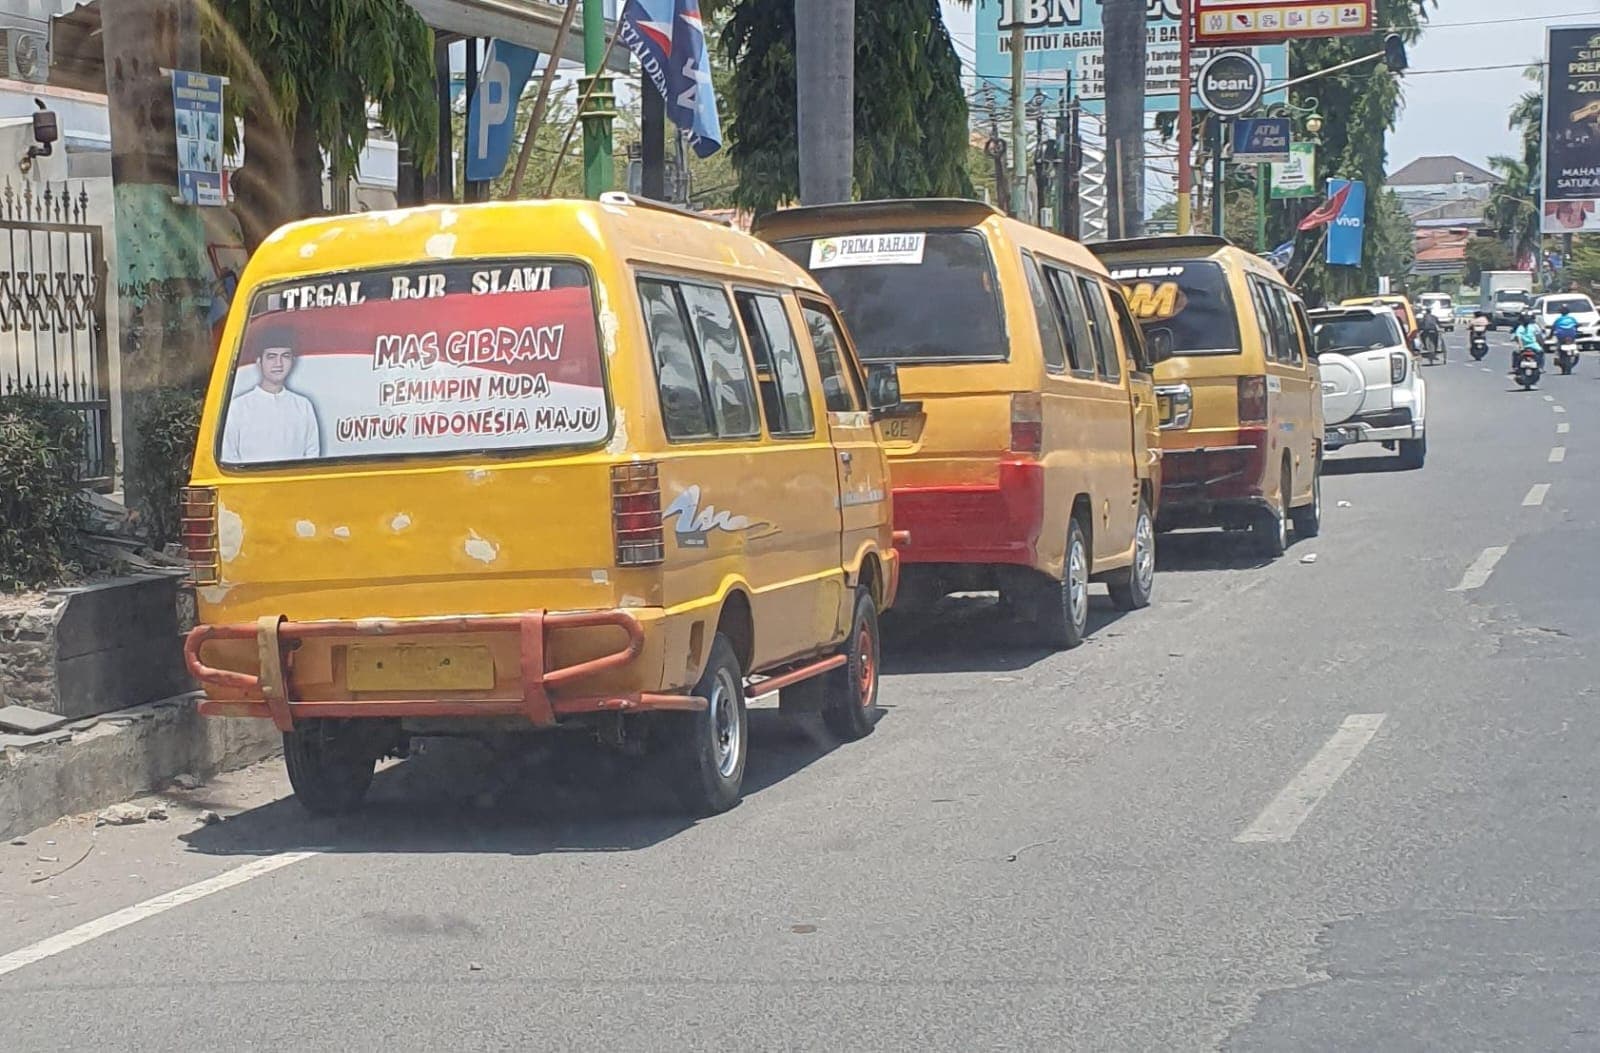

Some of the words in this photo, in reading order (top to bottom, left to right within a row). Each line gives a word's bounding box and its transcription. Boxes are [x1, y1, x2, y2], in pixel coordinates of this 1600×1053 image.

[1344, 8, 1357, 17] 24
[999, 34, 1060, 53] INTITUT
[1207, 75, 1254, 90] bean!
[1255, 125, 1280, 136] ATM
[1336, 215, 1360, 227] vivo
[840, 239, 874, 255] PRIMA
[878, 236, 920, 252] BAHARI
[283, 281, 366, 312] TEGAL
[391, 274, 446, 301] BJR
[471, 267, 552, 296] SLAWI
[373, 332, 439, 370] MAS
[446, 324, 565, 366] GIBRAN
[379, 377, 483, 406] PEMIMPIN
[487, 372, 552, 400] MUDA
[336, 414, 408, 442] UNTUK
[412, 407, 529, 439] INDONESIA
[534, 406, 601, 434] MAJU
